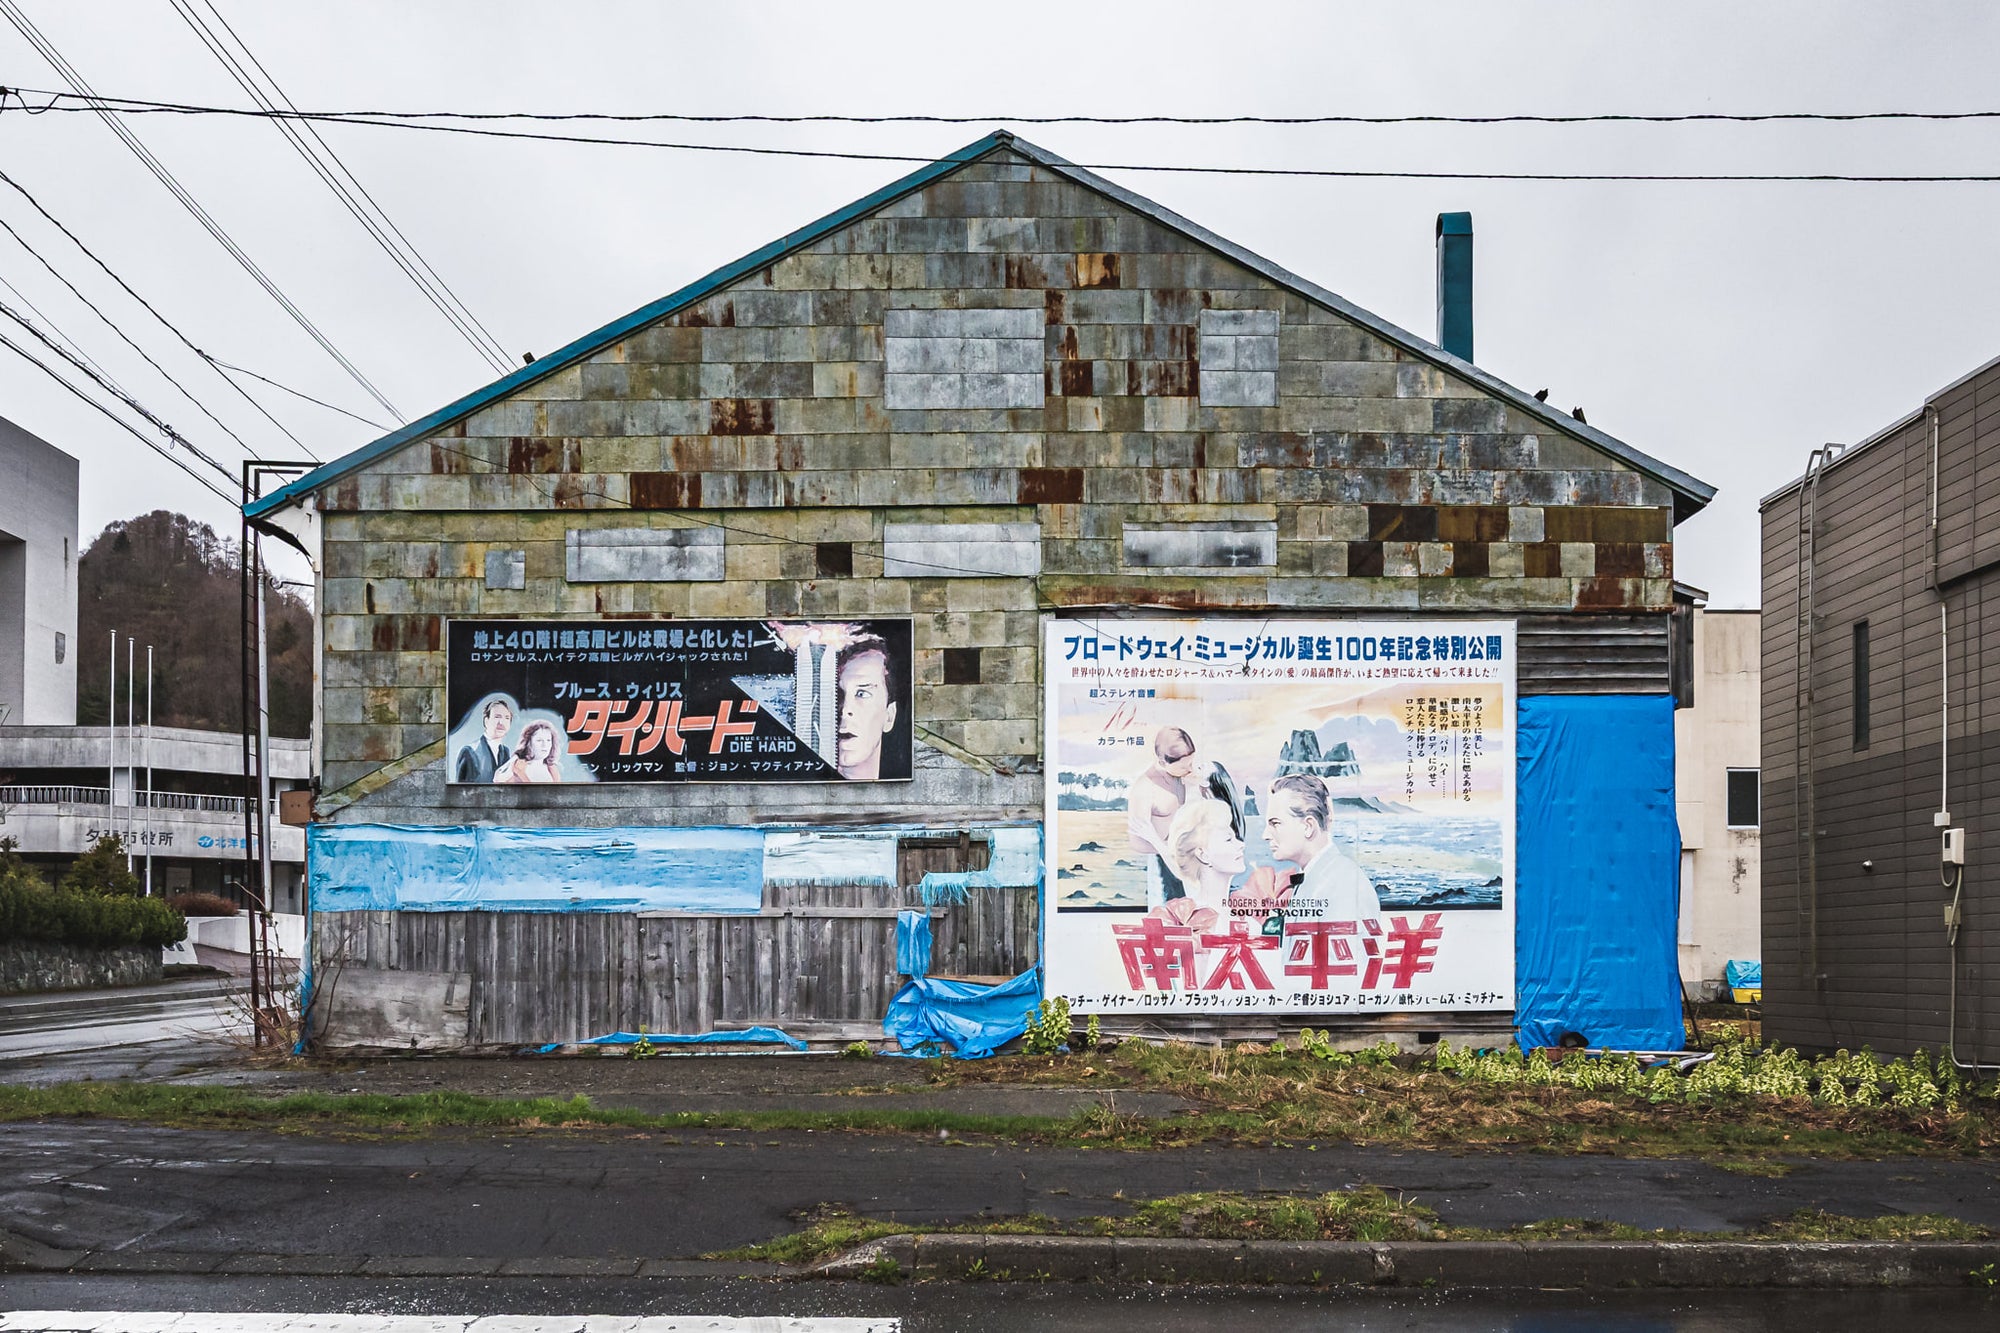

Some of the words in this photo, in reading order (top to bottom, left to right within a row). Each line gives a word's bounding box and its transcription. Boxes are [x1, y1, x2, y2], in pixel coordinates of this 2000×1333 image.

[1064, 635, 1502, 661] ブロードウェイ・ミュージカル誕生100年記念特別公開
[554, 682, 683, 699] ブルース・ウィリス
[1089, 689, 1156, 698] 超ステレオ音響
[567, 700, 760, 755] ダイ・ハード
[1416, 697, 1426, 758] 恋人たちに捧げる
[1473, 697, 1483, 757] 夢のように美しい
[730, 740, 753, 753] DIE
[758, 740, 797, 753] HARD
[1097, 737, 1145, 746] カラー作品
[1428, 697, 1437, 787] 華麗なるメロディにのせて
[1462, 697, 1472, 802] 南太平洋のかなたに燃えあがる
[86, 829, 173, 846] 夕市役所
[1222, 899, 1257, 907] RODGERS
[1277, 908, 1324, 917] PACIFIC
[1111, 912, 1444, 991] 南太平洋
